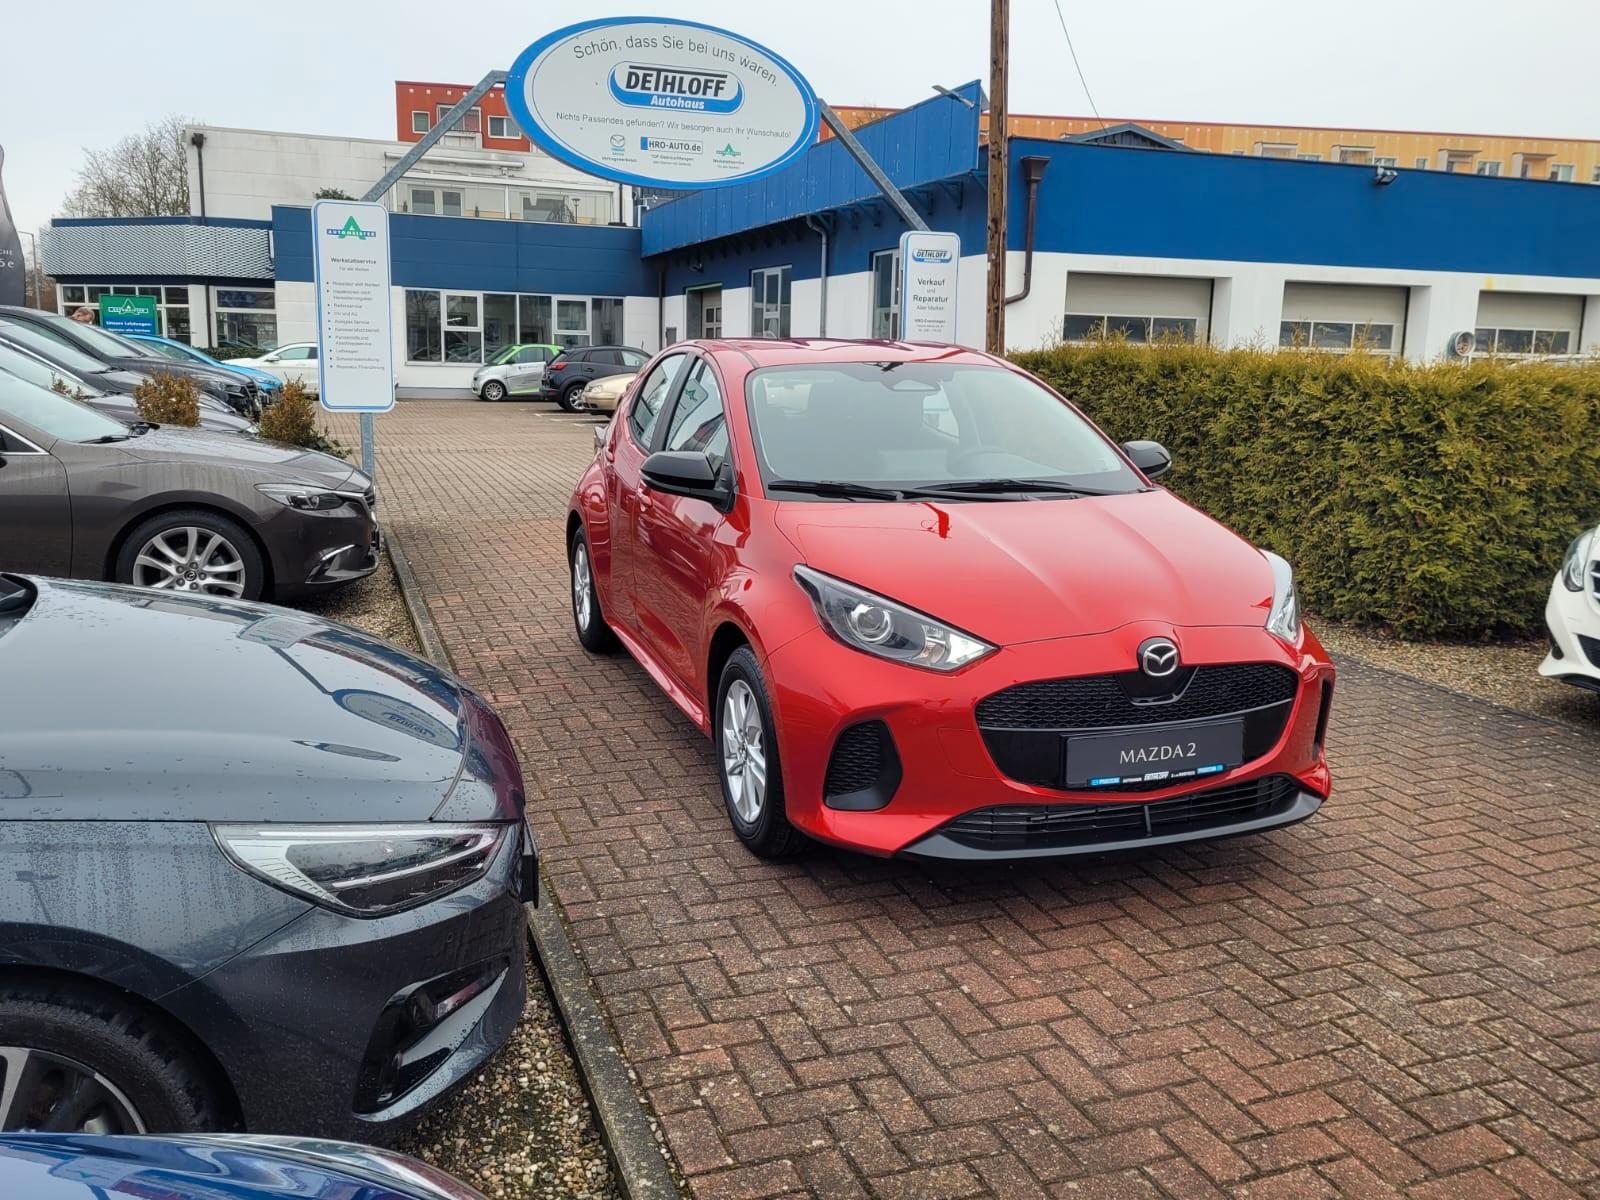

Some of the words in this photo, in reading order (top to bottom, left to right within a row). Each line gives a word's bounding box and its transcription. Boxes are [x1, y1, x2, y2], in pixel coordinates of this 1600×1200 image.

[573, 38, 622, 59] Schön,
[625, 35, 658, 48] dass
[662, 35, 684, 49] Sie
[688, 39, 708, 54] bei
[712, 47, 736, 62] uns
[740, 56, 777, 87] waren.
[625, 65, 728, 97] DETHLOFF
[650, 95, 705, 110] Autohaus
[556, 111, 580, 121] Nichts
[582, 113, 624, 126] Passendes
[625, 118, 665, 129] gefunden?
[666, 121, 679, 129] Wir
[680, 122, 715, 134] besorgen
[716, 126, 734, 134] auch
[735, 126, 744, 135] Ihr
[746, 127, 792, 138] Wunschauto!
[648, 140, 702, 152] HRO-AUTO.de
[917, 278, 945, 287] Verkauf
[913, 295, 948, 303] Reparatur
[1119, 744, 1184, 765] MAZDA
[1186, 742, 1197, 757] 2
